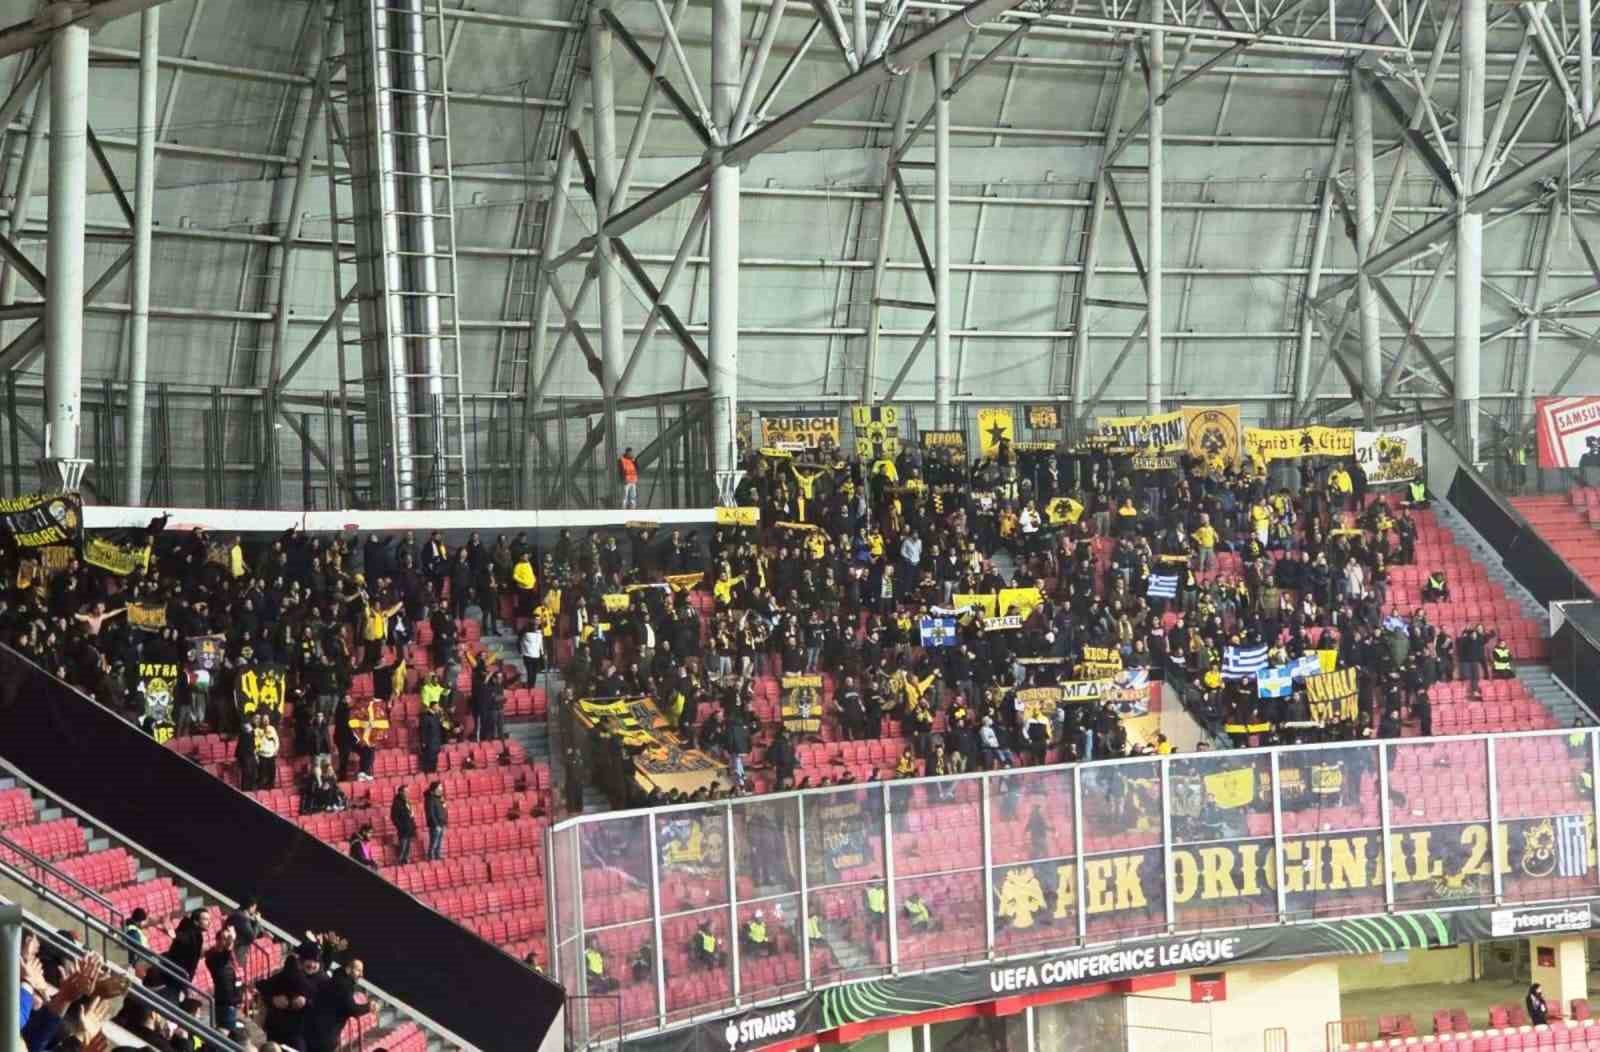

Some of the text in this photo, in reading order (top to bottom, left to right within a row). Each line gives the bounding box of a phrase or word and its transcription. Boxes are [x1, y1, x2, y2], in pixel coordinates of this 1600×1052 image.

[139, 664, 178, 677] PATRA
[1053, 824, 1513, 919] AEK ORIGINAL 21
[990, 938, 1235, 993] UEFA CONFERENCE LEAGUE
[740, 1009, 796, 1043] STRAUSS
